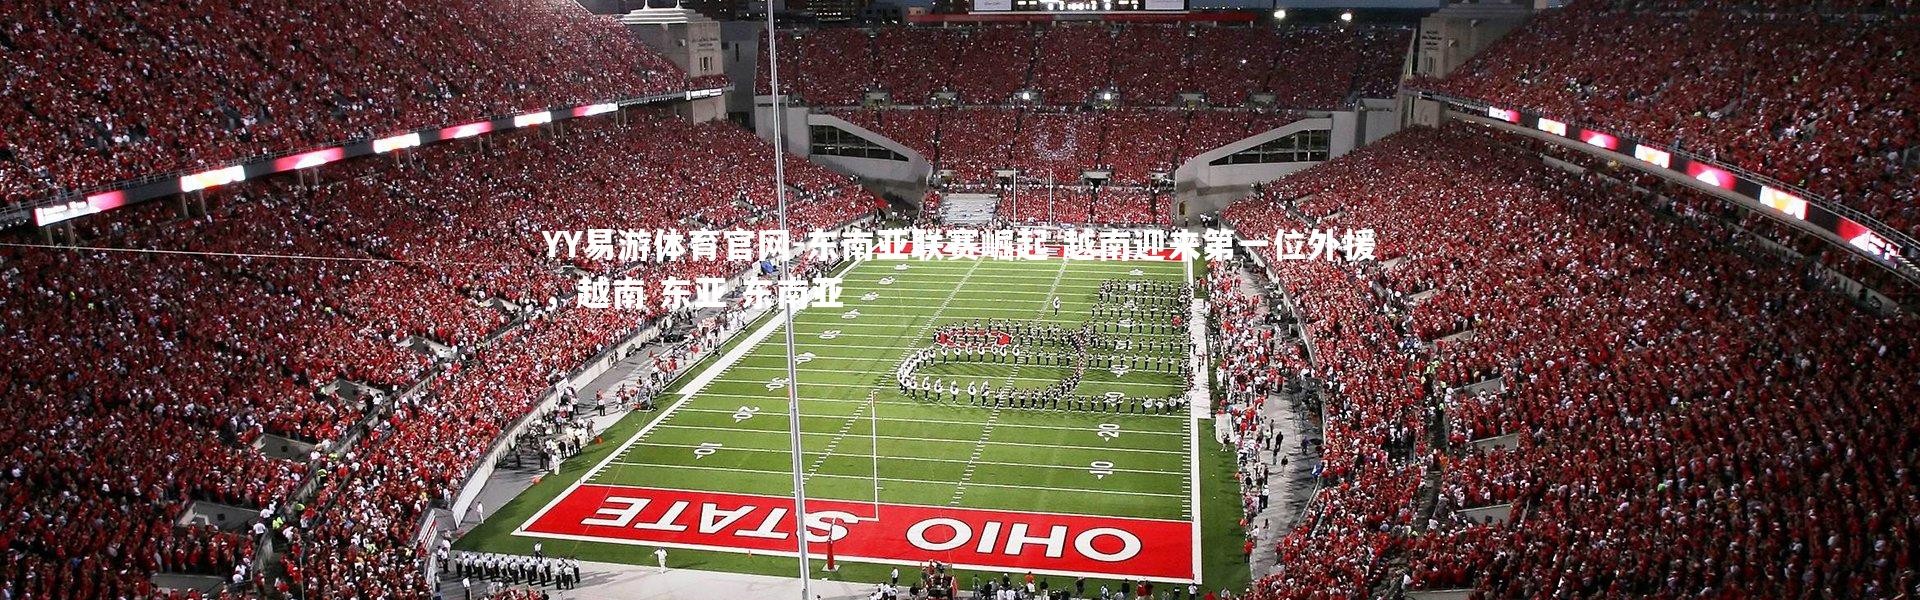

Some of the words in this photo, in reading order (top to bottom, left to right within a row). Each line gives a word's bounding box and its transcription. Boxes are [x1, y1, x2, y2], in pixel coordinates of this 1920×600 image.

[732, 405, 760, 419] 20
[1097, 424, 1120, 438] 20
[694, 442, 723, 455] 10
[1089, 461, 1114, 474] 10
[580, 496, 859, 543] STATE
[905, 516, 1142, 563] OHIO
